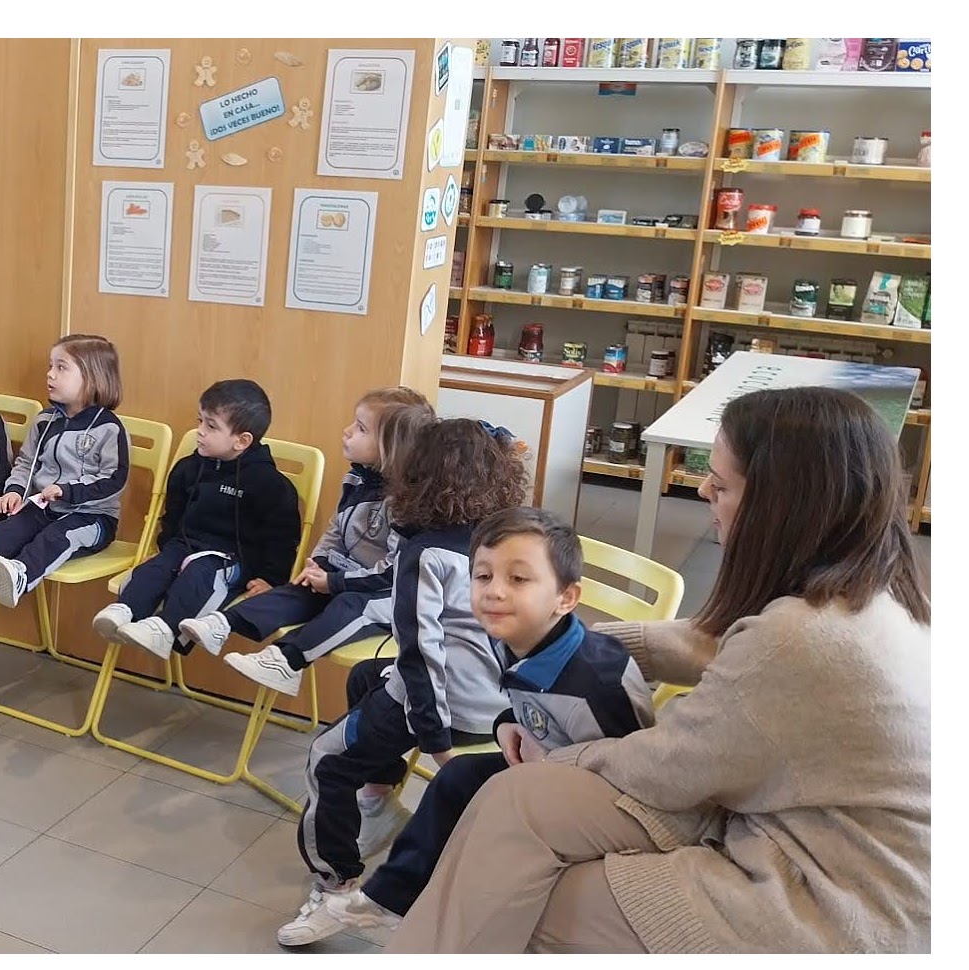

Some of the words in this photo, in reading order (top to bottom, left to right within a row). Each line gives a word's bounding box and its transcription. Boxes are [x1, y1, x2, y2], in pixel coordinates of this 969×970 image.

[219, 99, 230, 108] LO
[231, 89, 258, 104] HECHO
[223, 109, 234, 119] EN
[227, 116, 250, 129] VECES
[250, 104, 281, 121] BUENO!
